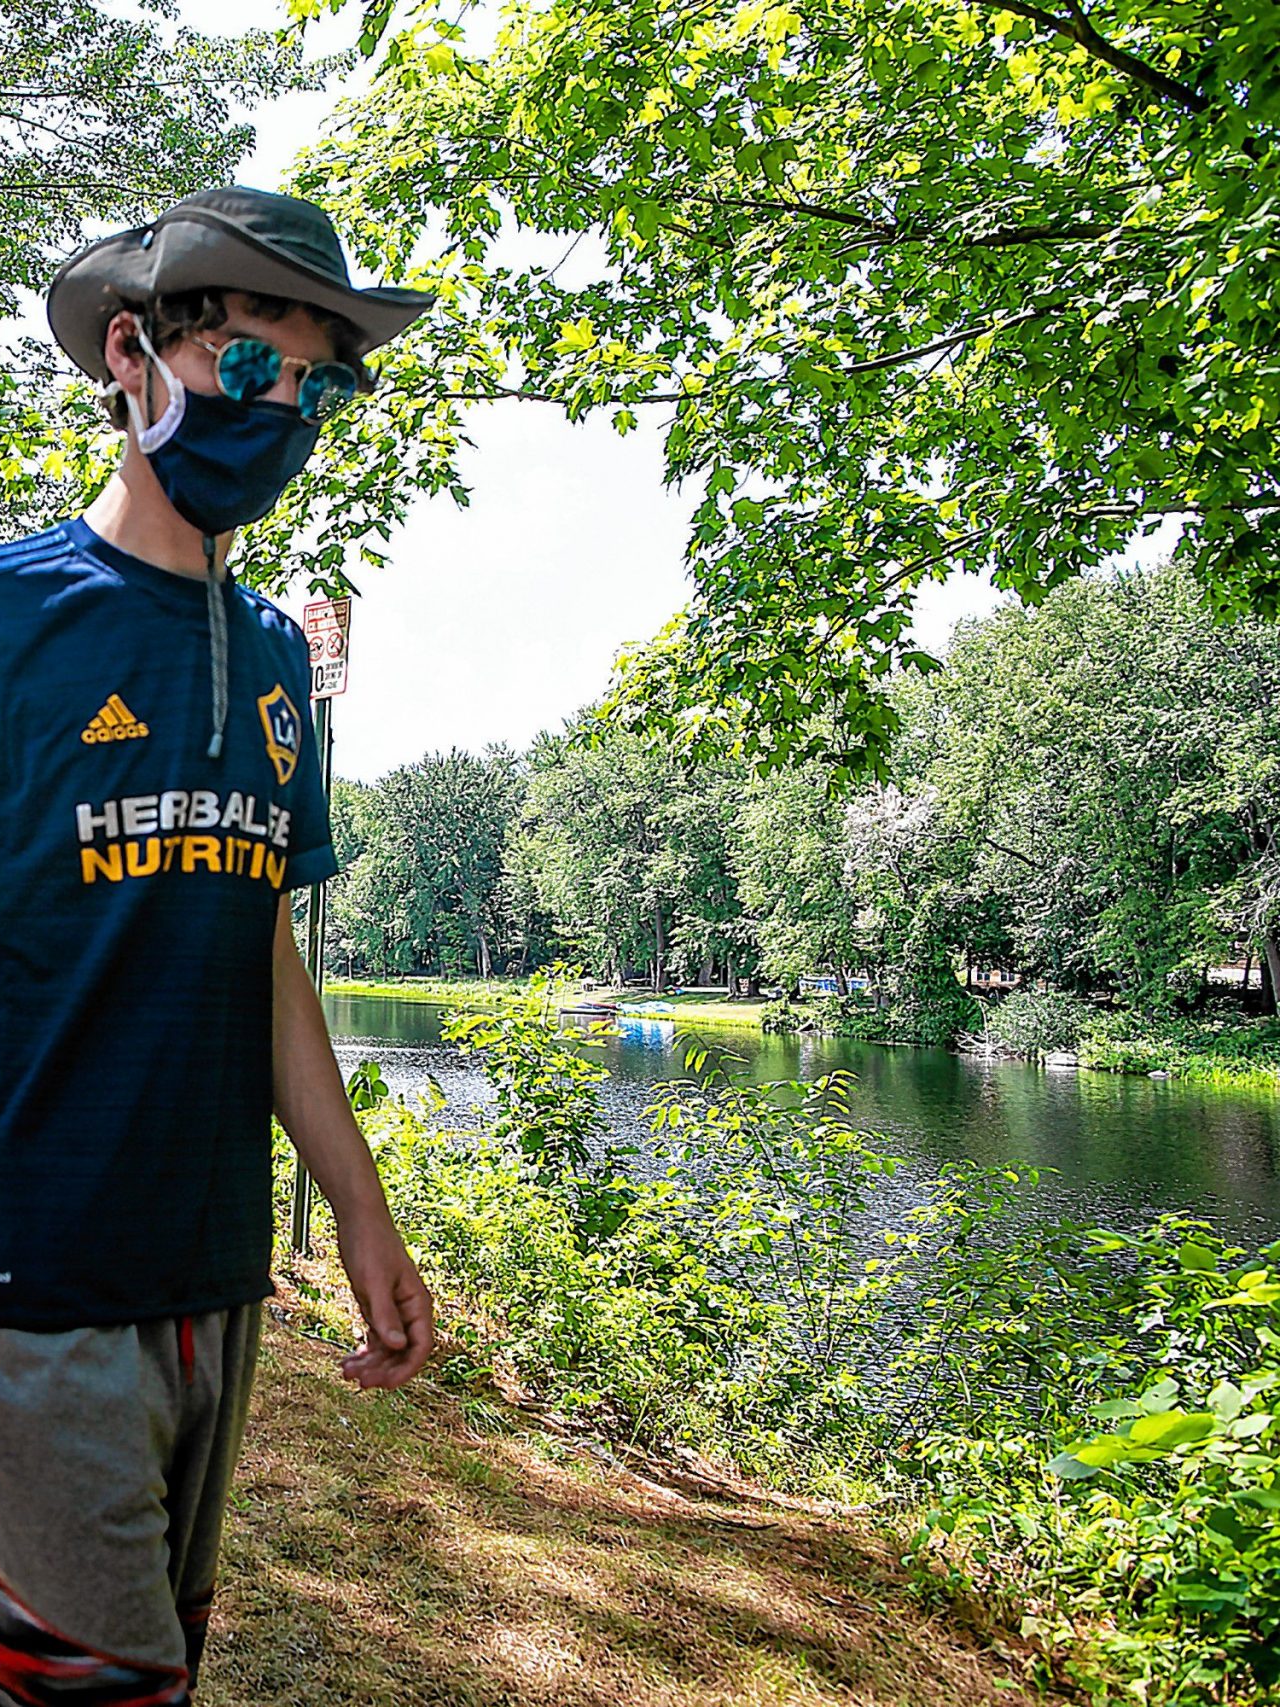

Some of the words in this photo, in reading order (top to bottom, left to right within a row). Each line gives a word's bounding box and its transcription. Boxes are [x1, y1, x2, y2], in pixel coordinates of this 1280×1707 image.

[81, 722, 150, 745] adidas
[274, 716, 297, 753] LA
[75, 790, 292, 849] HERBALFE
[79, 835, 288, 890] NUTRITIN
